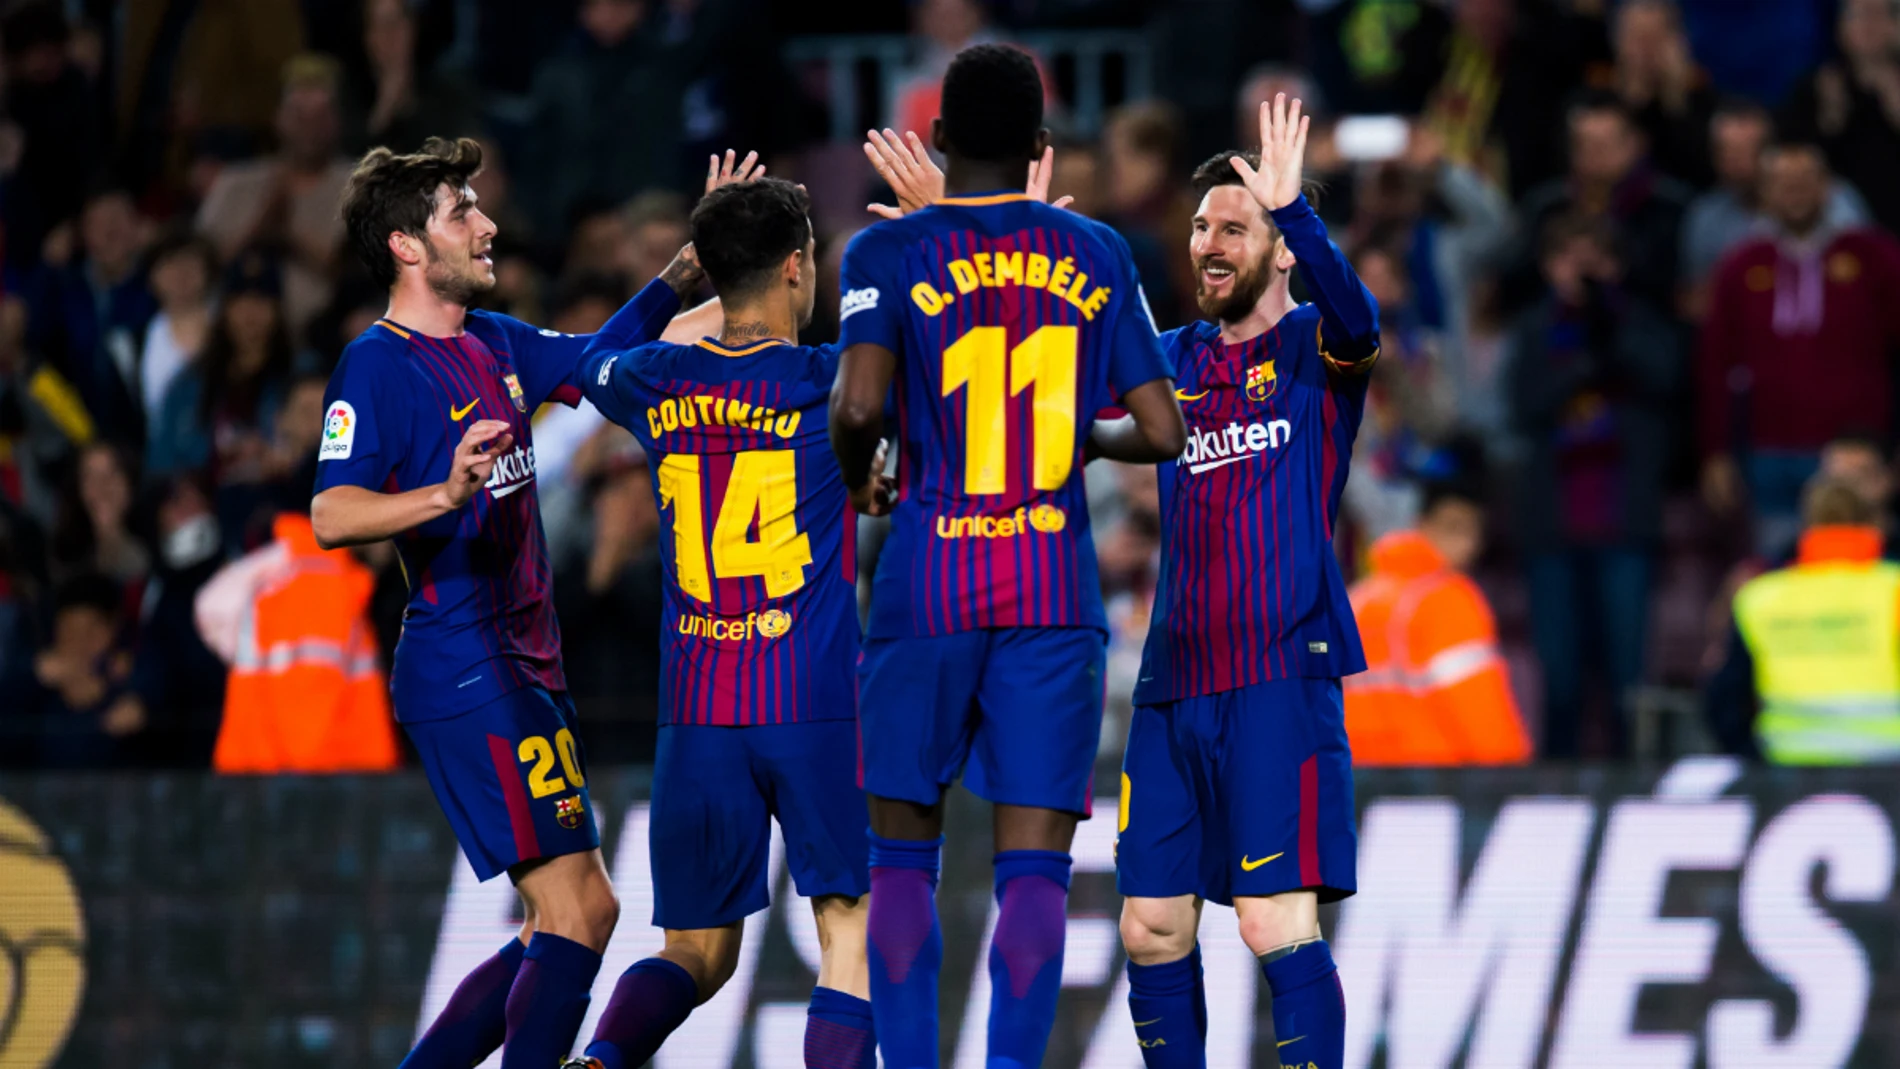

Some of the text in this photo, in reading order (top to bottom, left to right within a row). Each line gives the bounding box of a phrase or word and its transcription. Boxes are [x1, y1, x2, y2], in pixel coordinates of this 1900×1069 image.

[910, 251, 1111, 321] O. DEMBÉLÉ
[647, 395, 802, 439] COUTINHO
[942, 325, 1077, 494] 11
[1177, 419, 1291, 466] akuten
[657, 449, 813, 603] 14
[937, 506, 1026, 539] unicef
[679, 612, 757, 641] unicef
[518, 727, 584, 799] 20
[1334, 755, 1897, 1069] MÉS
